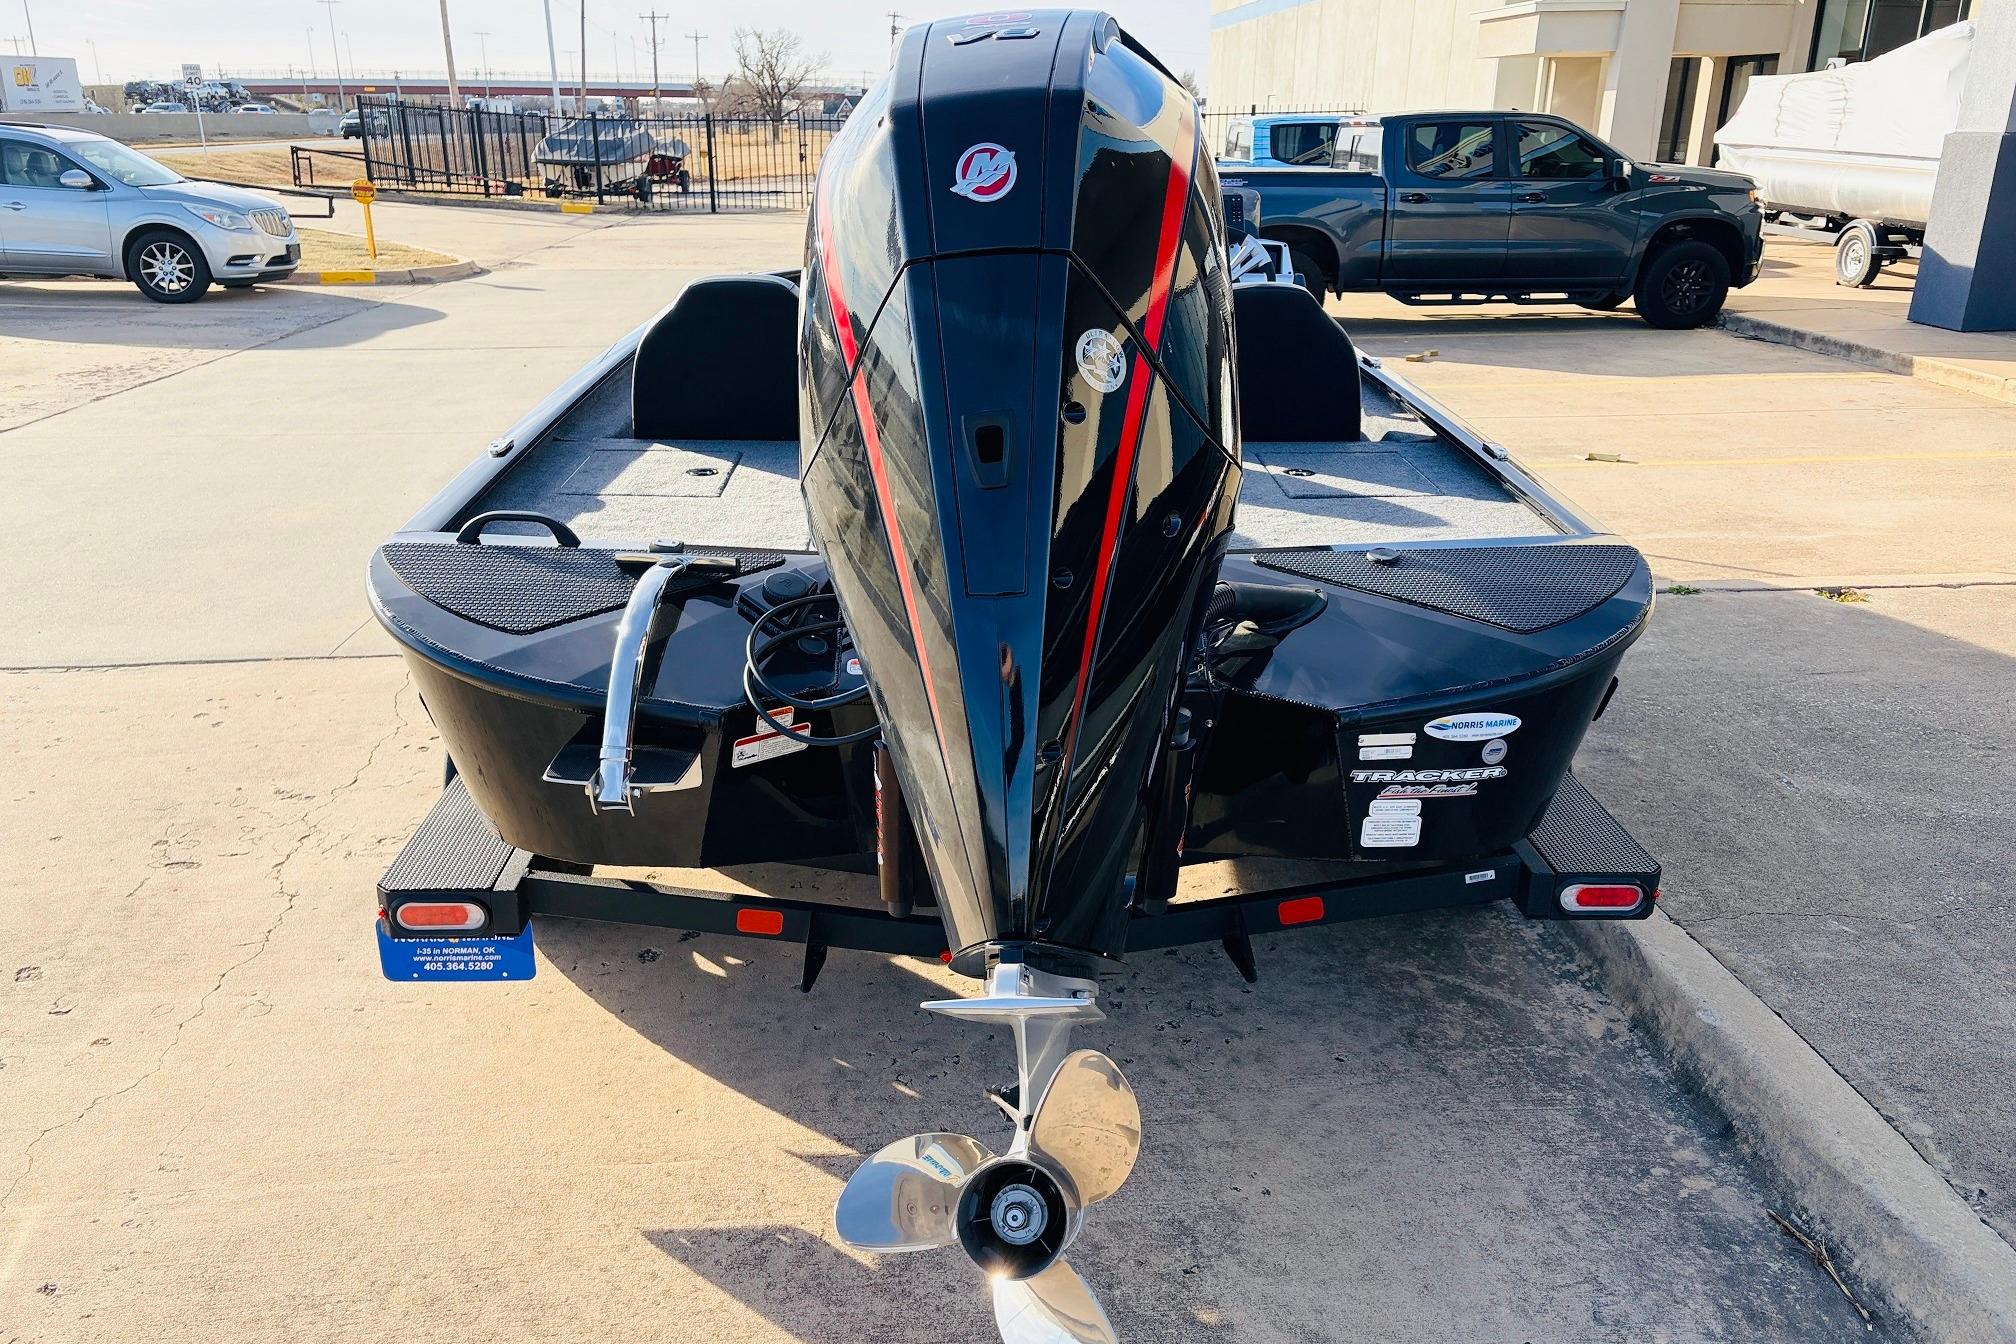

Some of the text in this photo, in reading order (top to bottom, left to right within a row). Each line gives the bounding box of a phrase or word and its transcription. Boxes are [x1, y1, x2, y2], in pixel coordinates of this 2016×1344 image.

[185, 76, 201, 85] 40
[1451, 718, 1518, 729] NORRIS MARINE
[1352, 767, 1502, 781] TRACKER
[442, 947, 481, 955] NORMAN,
[482, 946, 496, 954] OK
[424, 962, 493, 970] 405.364.5280
